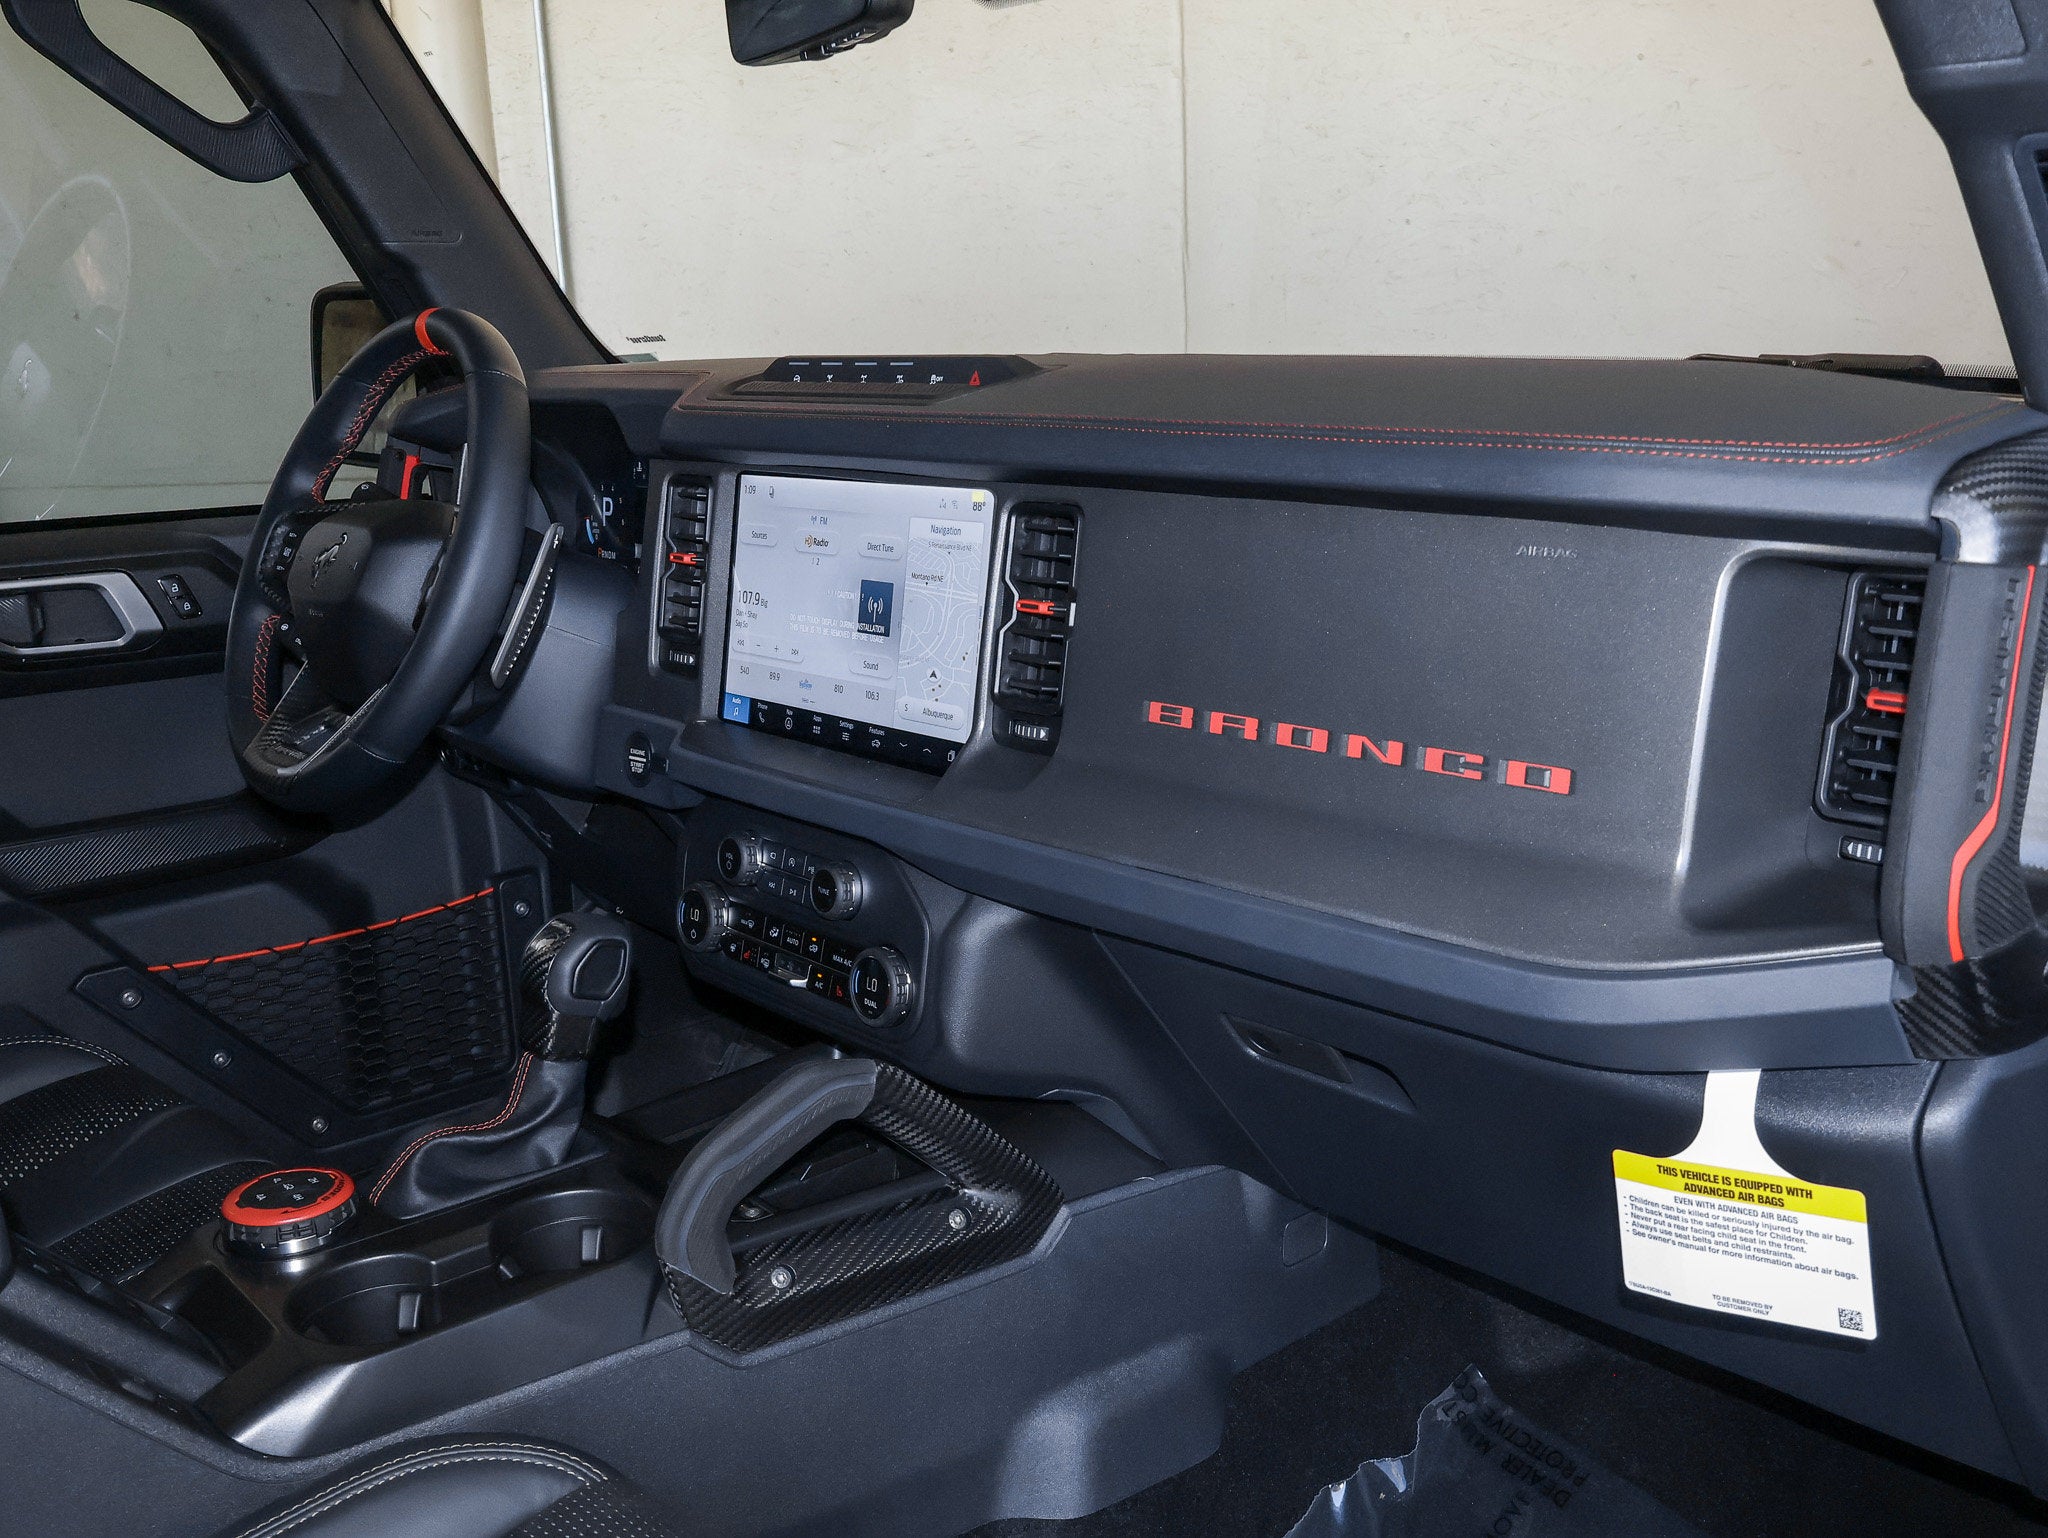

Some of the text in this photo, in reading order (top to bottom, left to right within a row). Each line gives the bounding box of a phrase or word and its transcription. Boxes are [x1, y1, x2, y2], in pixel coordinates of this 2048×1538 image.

[603, 497, 613, 526] P
[820, 517, 828, 525] FM
[751, 531, 767, 540] Sources
[931, 525, 961, 536] Navigation
[813, 538, 829, 548] Radio
[867, 542, 894, 553] Direct Tune
[738, 590, 761, 605] 107.9
[863, 660, 879, 671] Sound
[865, 690, 880, 701] 106.3
[757, 702, 768, 711] Phone
[923, 707, 953, 721] Albuquerque
[839, 720, 854, 730] Settings
[869, 727, 885, 737] Features
[1145, 700, 1573, 795] BRONCO
[787, 936, 799, 946] AUTO
[833, 954, 852, 968] MAX A/C
[815, 981, 823, 990] A/C
[864, 998, 877, 1009] DUAL
[1657, 1165, 1813, 1199] THIS VEHICLE IS EQUIPPED WITH
[1684, 1183, 1784, 1208] ADVANCED AIR BAGS
[1674, 1196, 1798, 1224] EVEN WITH ADVANCED AIR BAGS
[1629, 1195, 1659, 1208] Children
[1661, 1203, 1675, 1212] can
[1677, 1206, 1686, 1215] be
[1688, 1209, 1709, 1219] killed
[1722, 1215, 1759, 1228] seriously
[1762, 1221, 1791, 1233] injured
[1793, 1226, 1803, 1236] by
[1806, 1229, 1820, 1238] the
[1822, 1232, 1833, 1240] air
[1835, 1234, 1854, 1245] bag.
[1630, 1203, 1643, 1213] The
[1645, 1207, 1663, 1217] back
[1664, 1213, 1680, 1221] seat
[1691, 1218, 1703, 1226] the
[1706, 1221, 1730, 1230] safest
[1732, 1225, 1754, 1235] place
[1756, 1228, 1767, 1236] for
[1770, 1231, 1808, 1245] Children.
[1631, 1212, 1652, 1222] Never
[1654, 1217, 1666, 1226] put
[1674, 1223, 1688, 1232] rear
[1691, 1225, 1715, 1238] facing
[1717, 1231, 1737, 1241] child
[1739, 1235, 1757, 1244] seat
[1768, 1240, 1781, 1249] the
[1784, 1243, 1807, 1253] front.
[1631, 1221, 1795, 1260] Always use seat belts and child restraints.
[1632, 1229, 1859, 1280] See owner's manual for more information about air bags.
[1717, 1301, 1751, 1312] CUSTOMER
[1732, 1298, 1762, 1308] REMOVED
[1480, 1405, 1591, 1489] PROTECTIVE
